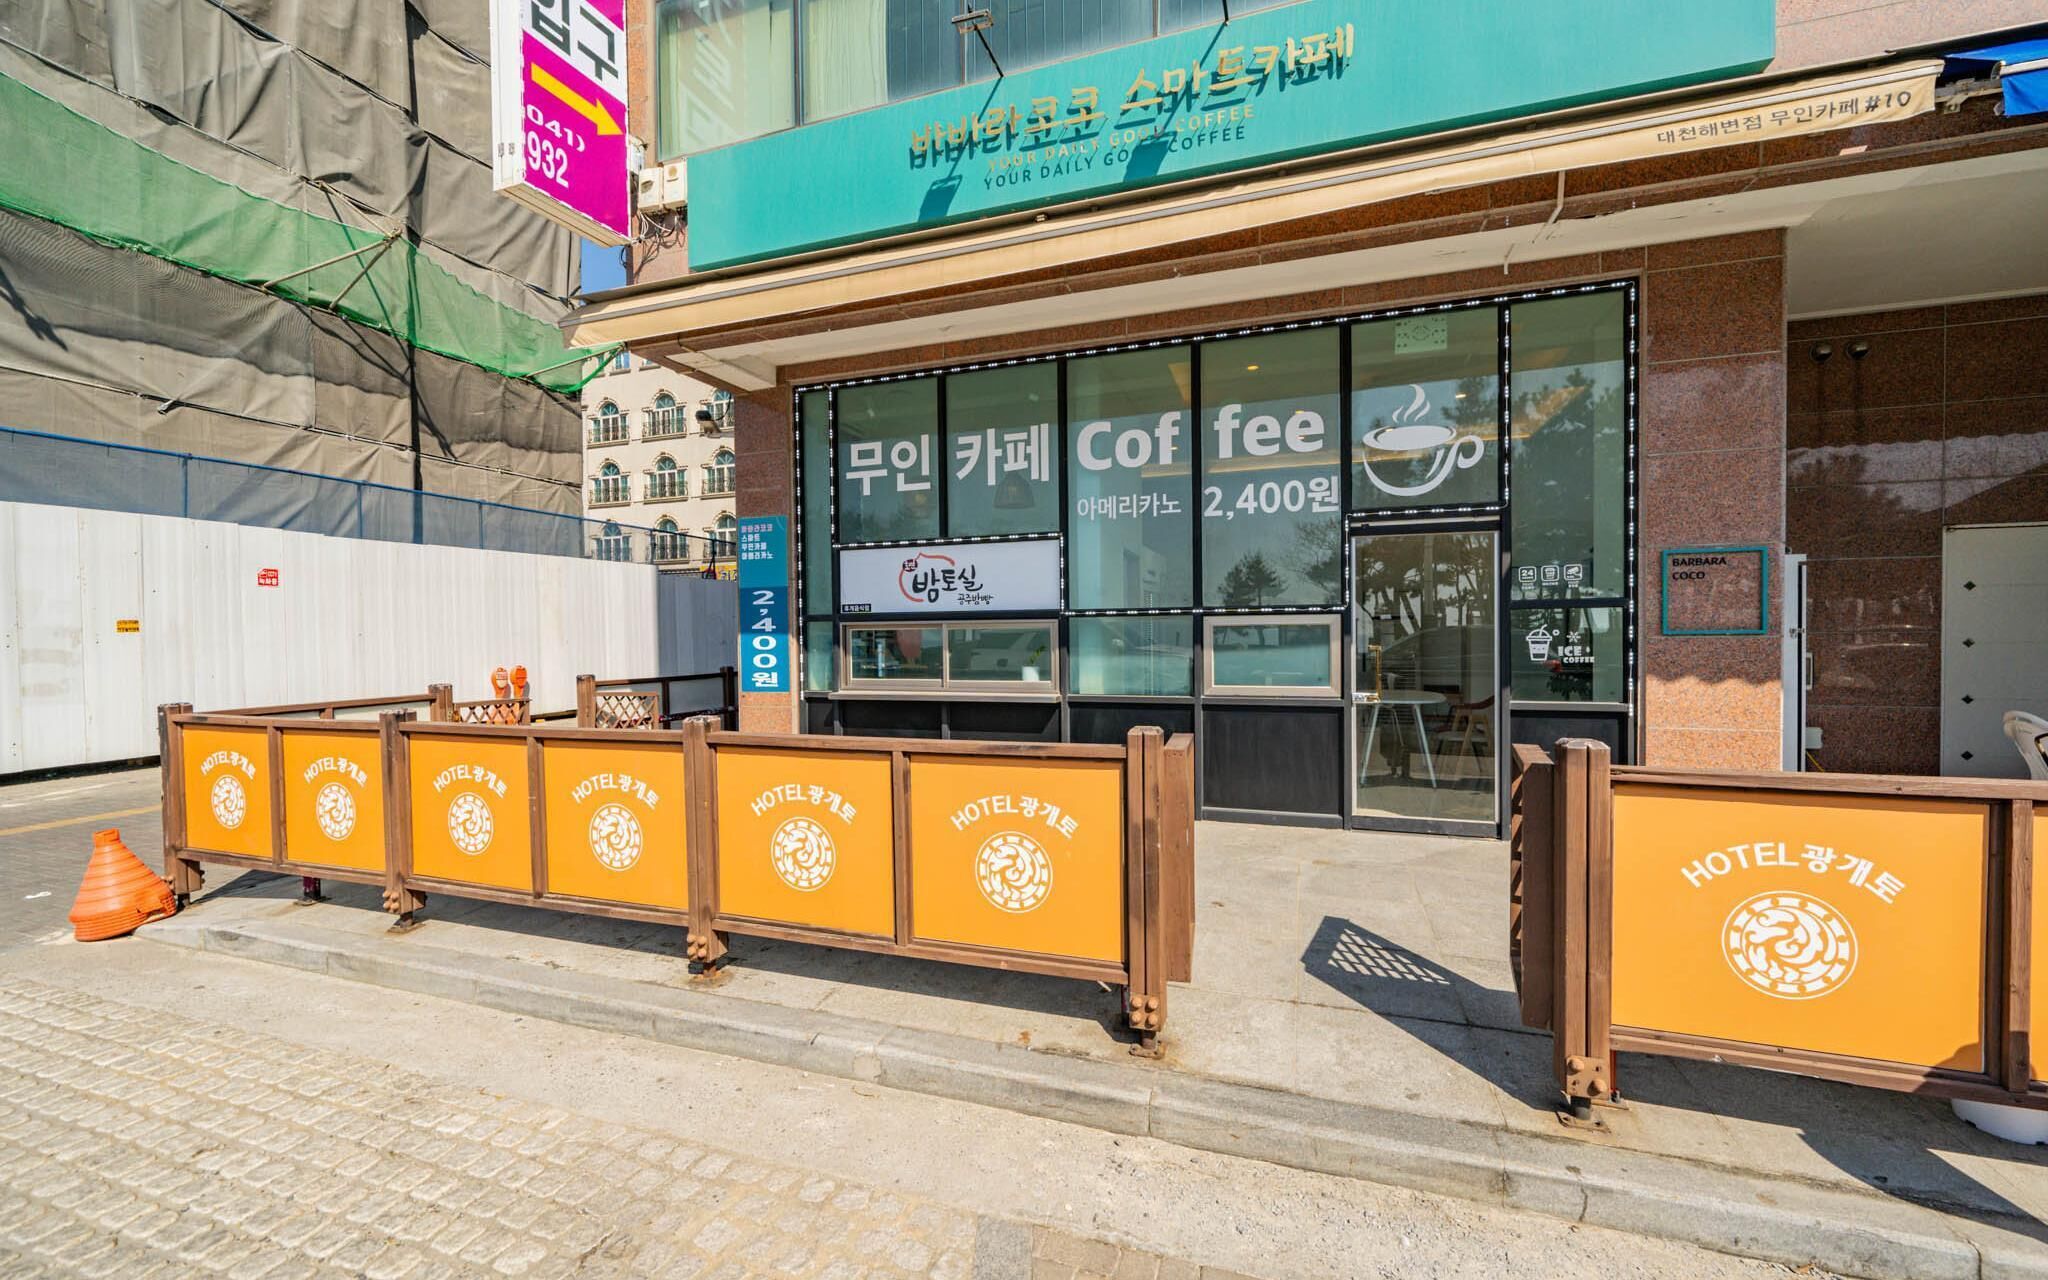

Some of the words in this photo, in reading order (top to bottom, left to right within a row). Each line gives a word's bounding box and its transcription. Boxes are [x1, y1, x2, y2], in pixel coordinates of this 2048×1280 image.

[911, 86, 1105, 153] 바바라코코
[1119, 22, 1354, 112] 스마트카페
[1656, 114, 1763, 144] 대천해변점
[1769, 96, 1860, 126] 무인카페
[1863, 90, 1912, 114] #10
[527, 130, 569, 188] 932
[845, 433, 932, 496] 무인
[955, 423, 1050, 486] 카페
[1076, 410, 1182, 471] Cof
[1212, 402, 1326, 460] fee
[1077, 492, 1183, 522] 아메리카노
[1203, 474, 1339, 521] 2,400원
[911, 564, 983, 603] 밤토실
[1672, 557, 1727, 567] BARBARA
[1672, 571, 1706, 581] COCO
[751, 589, 779, 688] 2,400원
[1557, 645, 1582, 657] ICE
[1563, 656, 1595, 664] COFFEE
